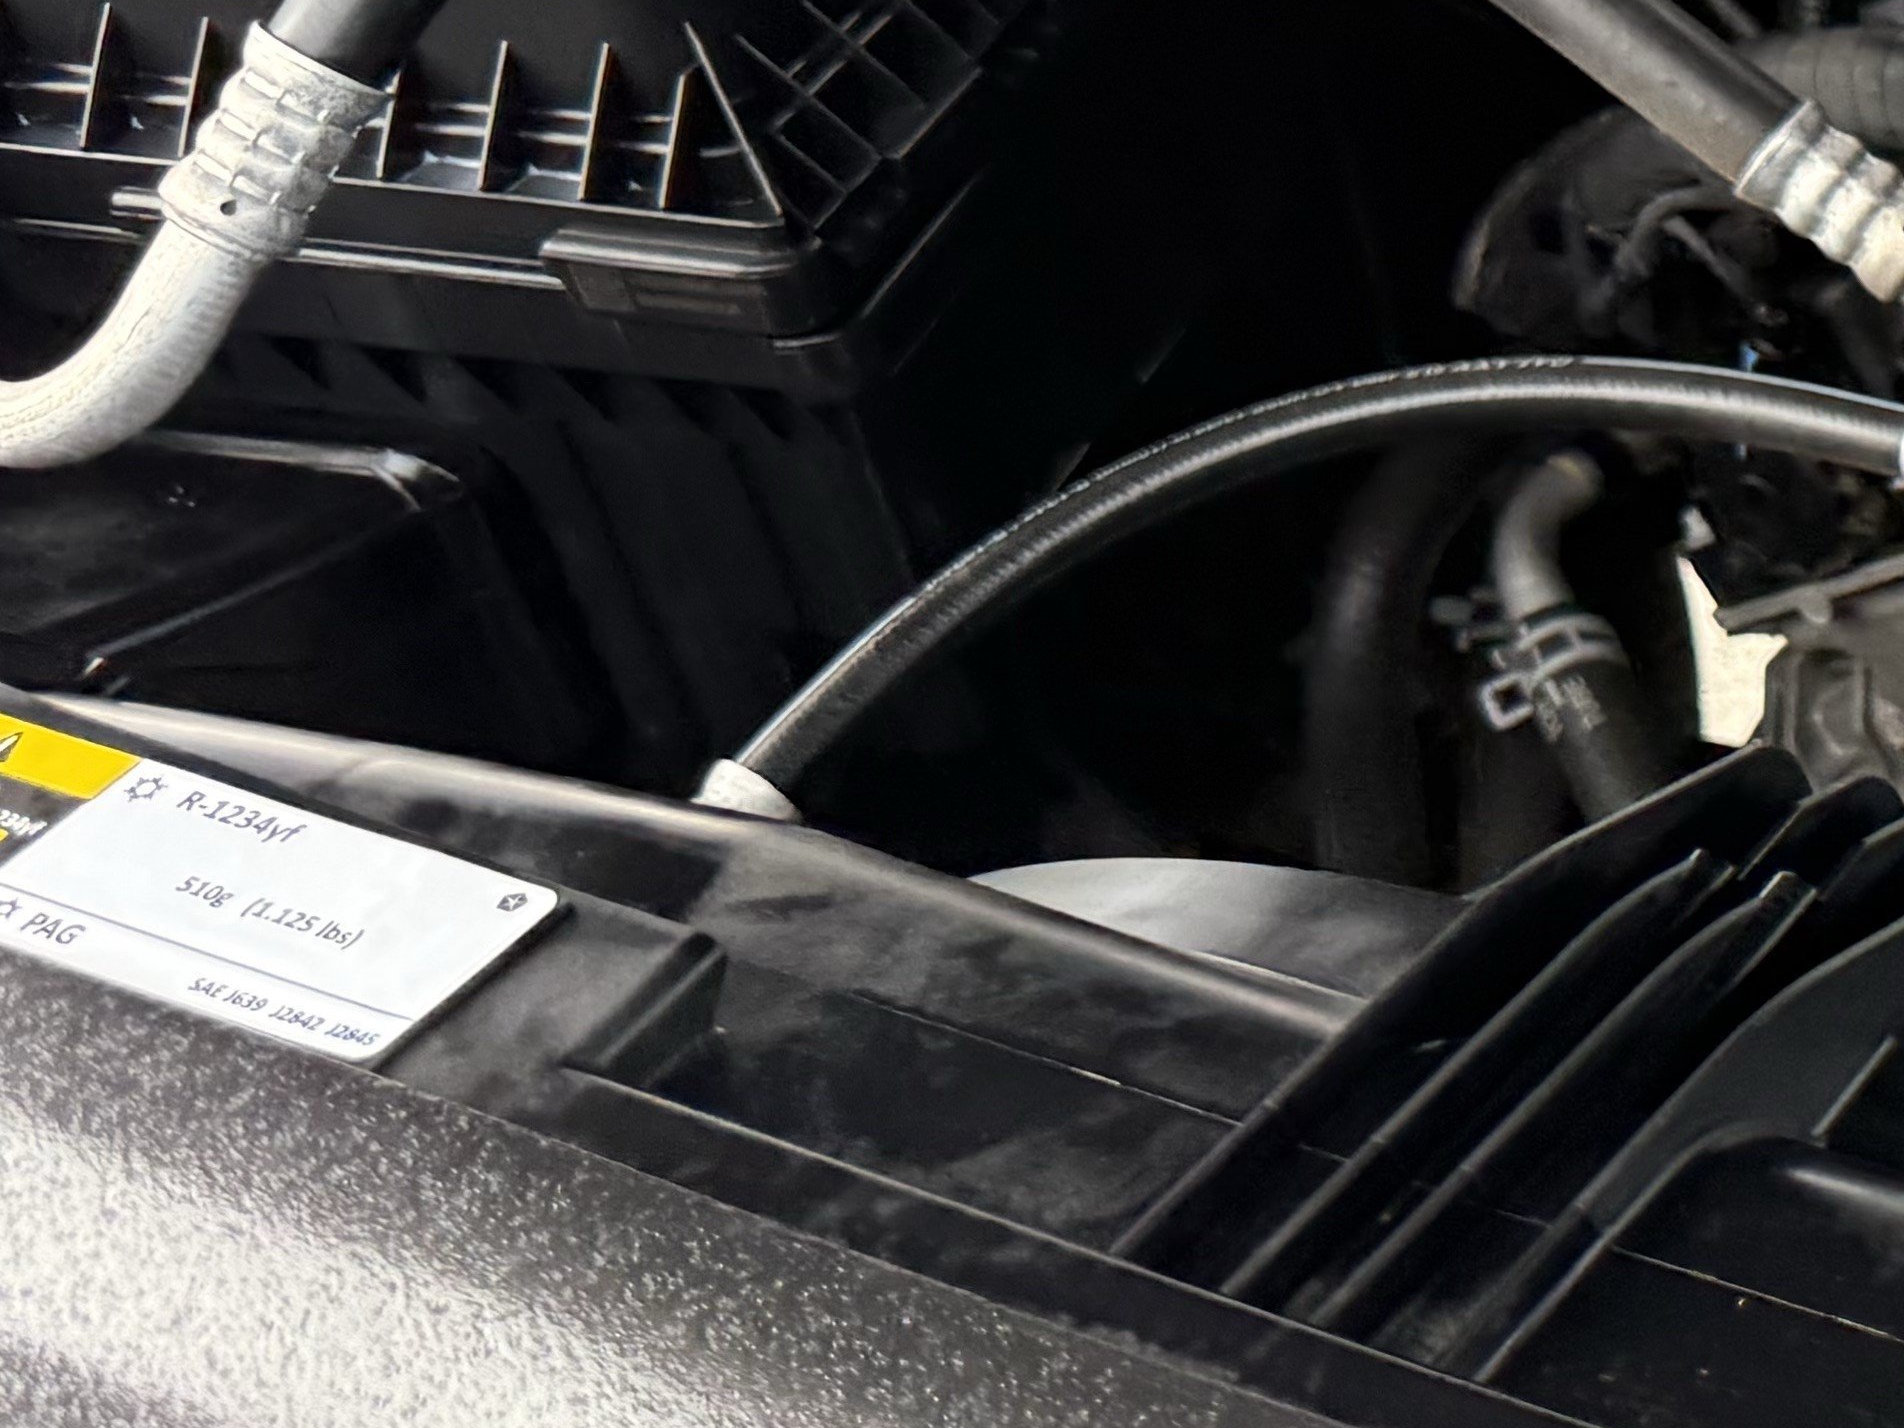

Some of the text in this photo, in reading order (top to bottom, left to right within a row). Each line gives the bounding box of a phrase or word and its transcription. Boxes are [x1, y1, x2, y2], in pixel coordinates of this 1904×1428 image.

[176, 789, 307, 843] R-1234yf
[20, 912, 86, 946] PAG
[175, 875, 365, 950] 510g (1.125 lbs)
[187, 976, 224, 998] SAE
[222, 988, 269, 1012] J639
